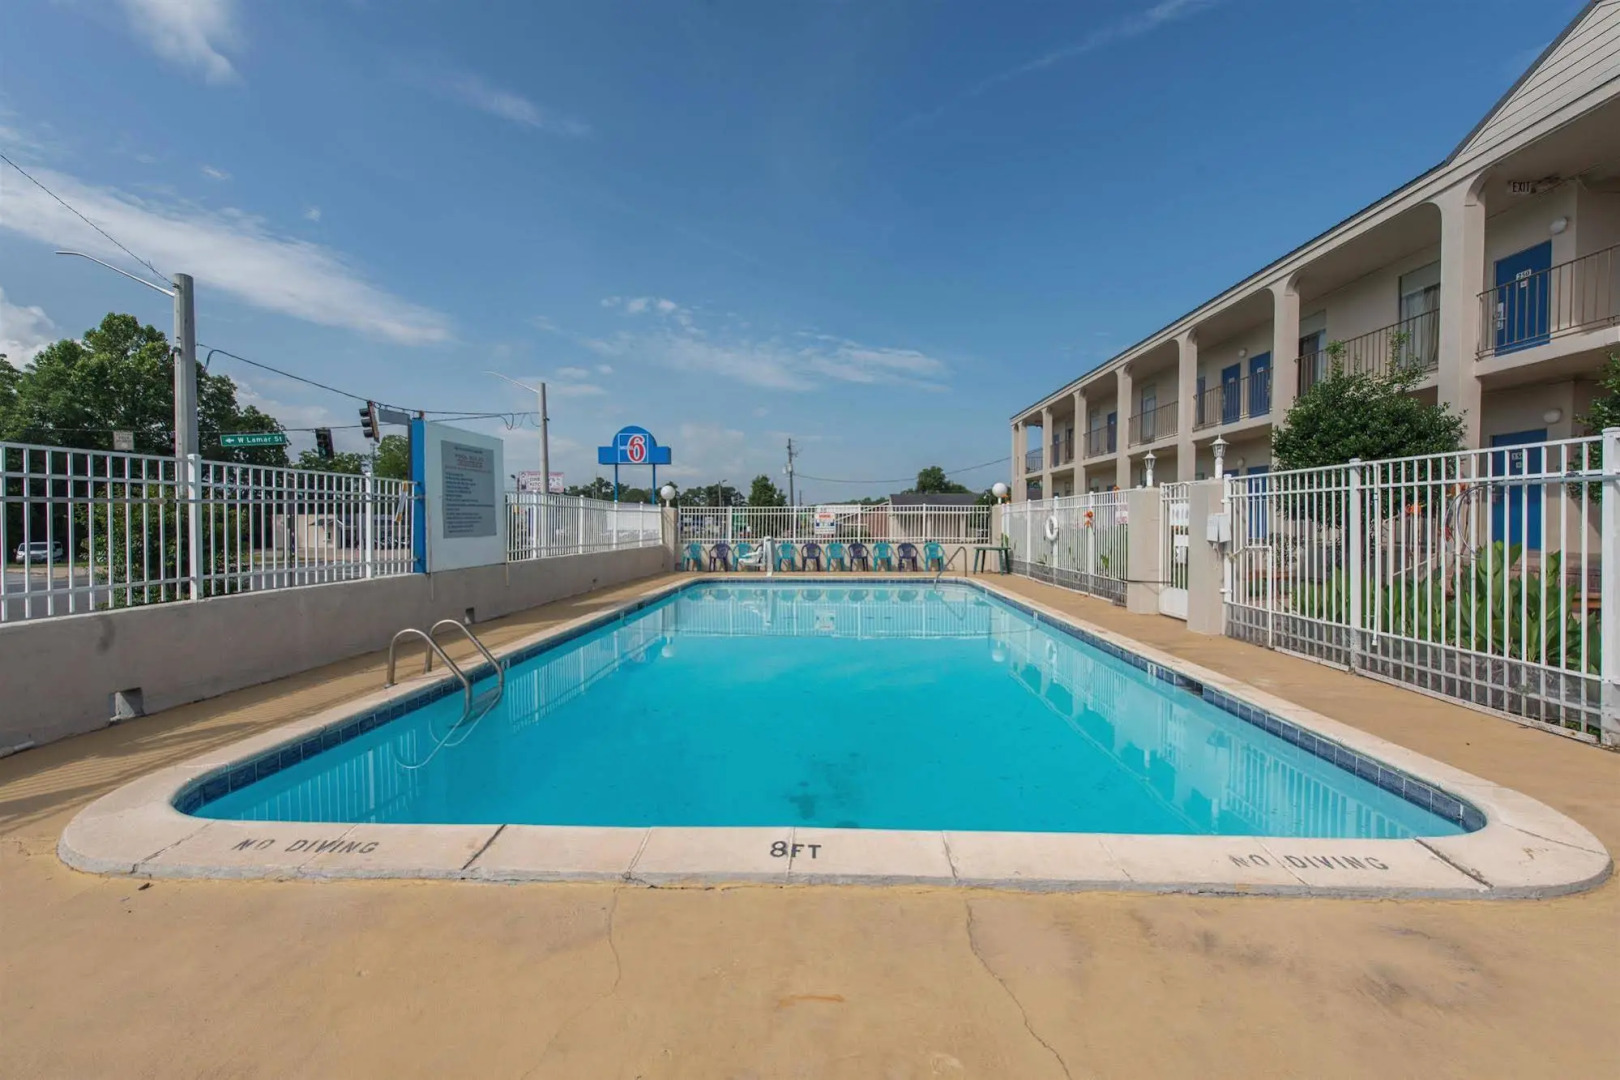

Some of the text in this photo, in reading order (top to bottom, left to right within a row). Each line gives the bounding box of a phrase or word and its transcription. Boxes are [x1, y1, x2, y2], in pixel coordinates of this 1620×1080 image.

[1512, 181, 1530, 193] EXIT
[627, 434, 647, 463] 6
[232, 838, 379, 854] NO DIVING
[769, 840, 822, 859] 8FT
[1228, 854, 1389, 870] NO DIVING
